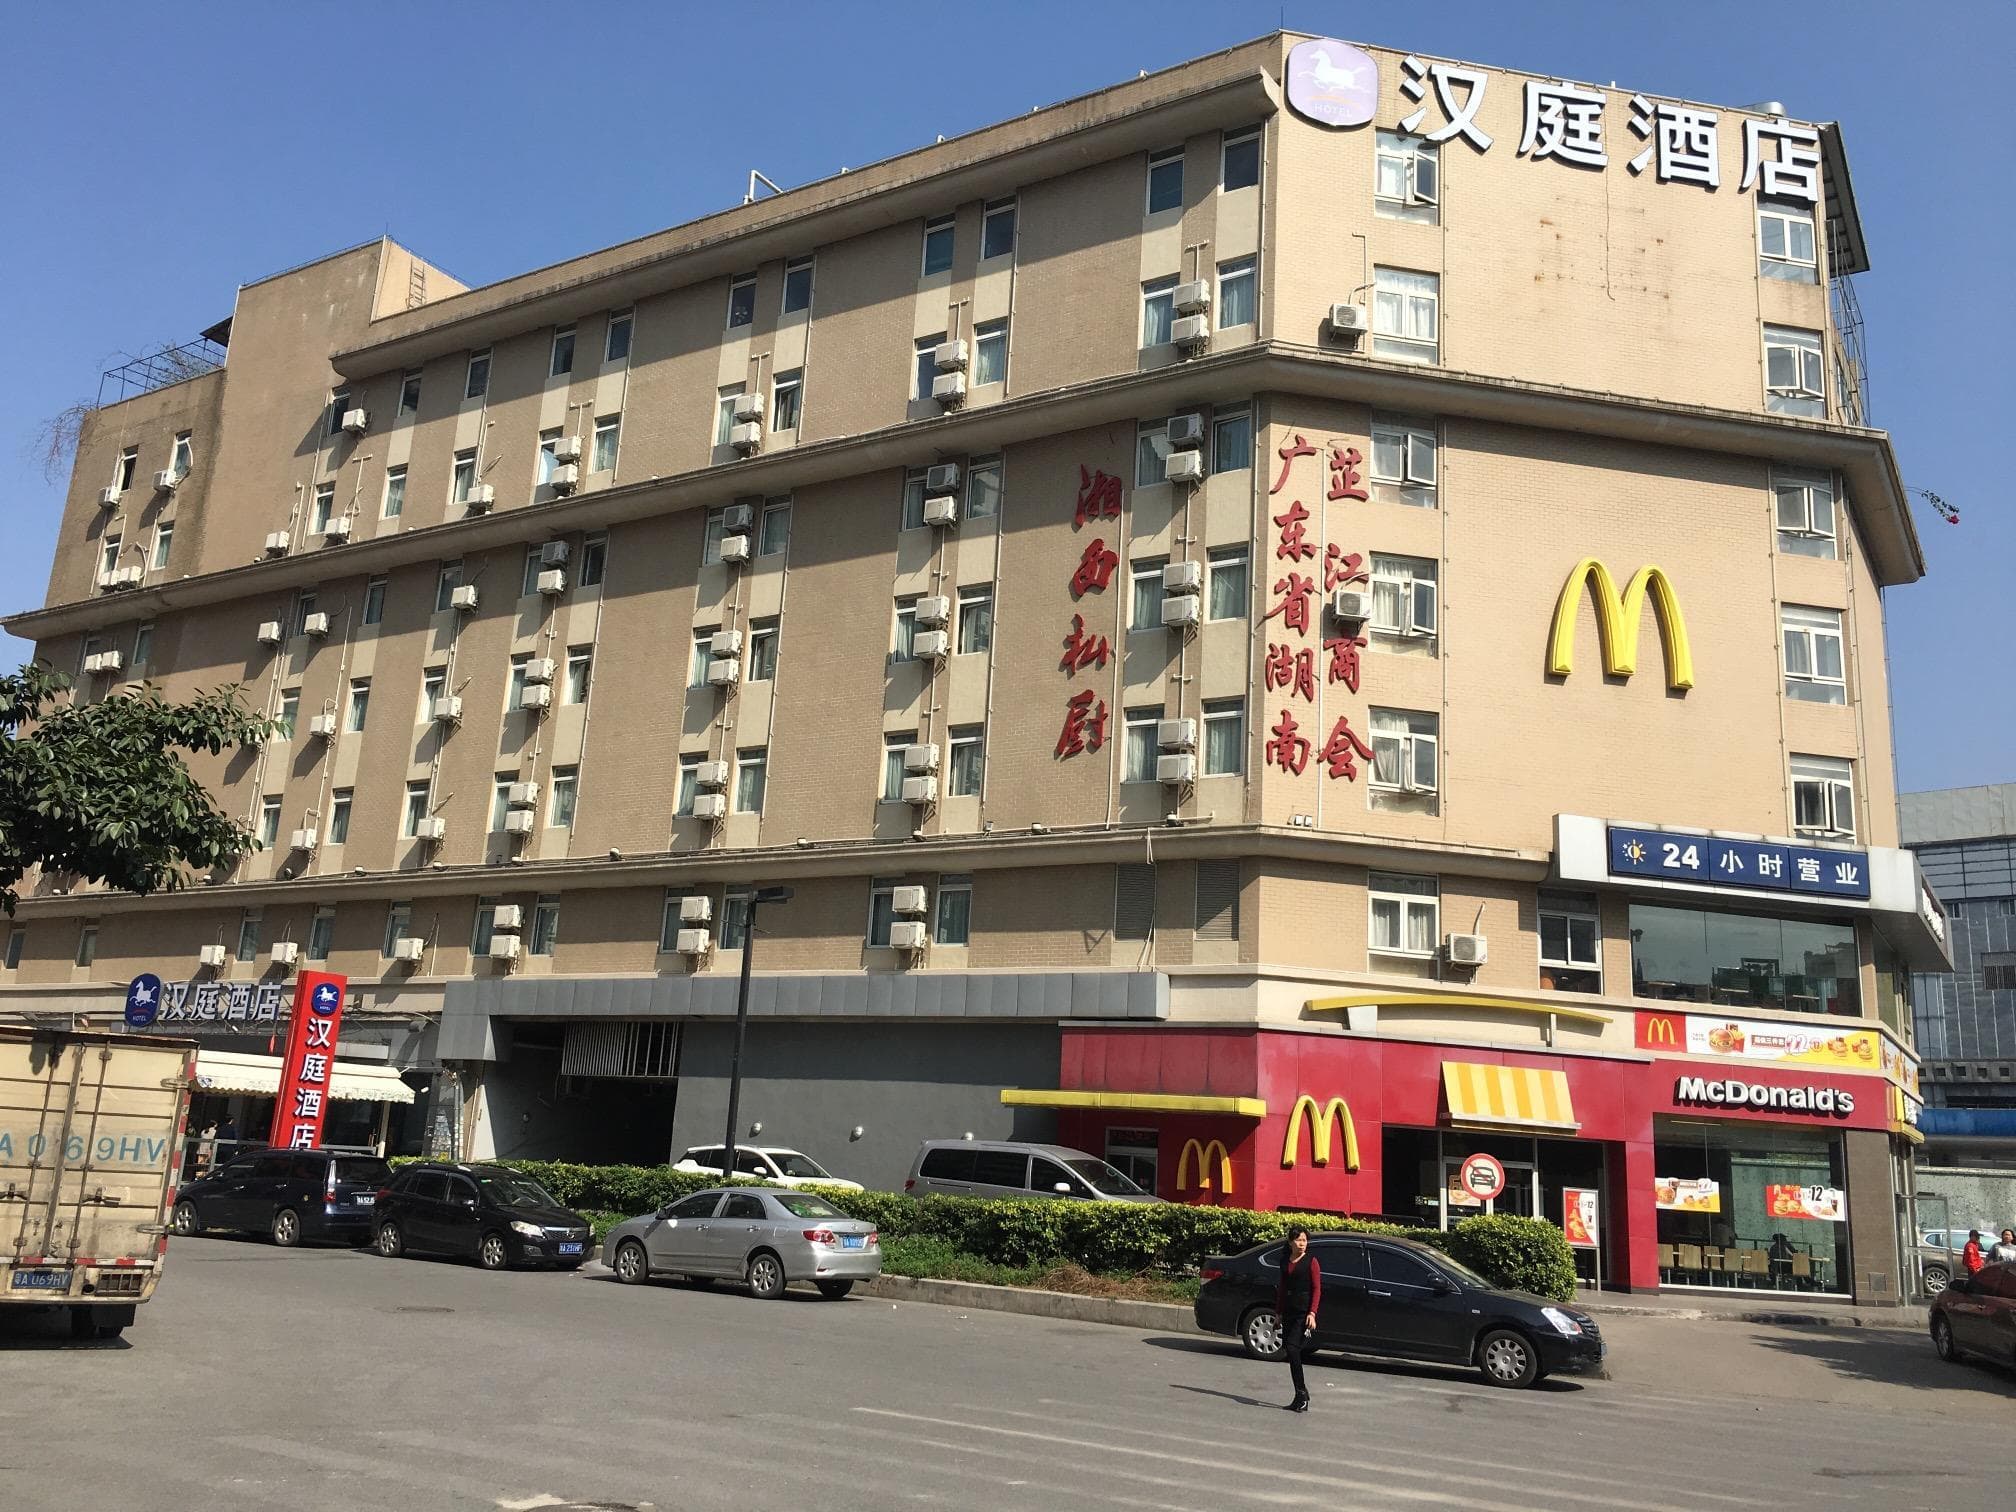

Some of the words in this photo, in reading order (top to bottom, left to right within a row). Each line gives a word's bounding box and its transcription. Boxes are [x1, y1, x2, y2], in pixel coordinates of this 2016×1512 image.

[1314, 103, 1352, 117] HOTEL
[1401, 55, 1820, 202] 汉庭酒店
[161, 981, 282, 1021] 汉庭酒店
[288, 1017, 333, 1149] 汉庭酒店
[1678, 1077, 1855, 1113] McDonald's
